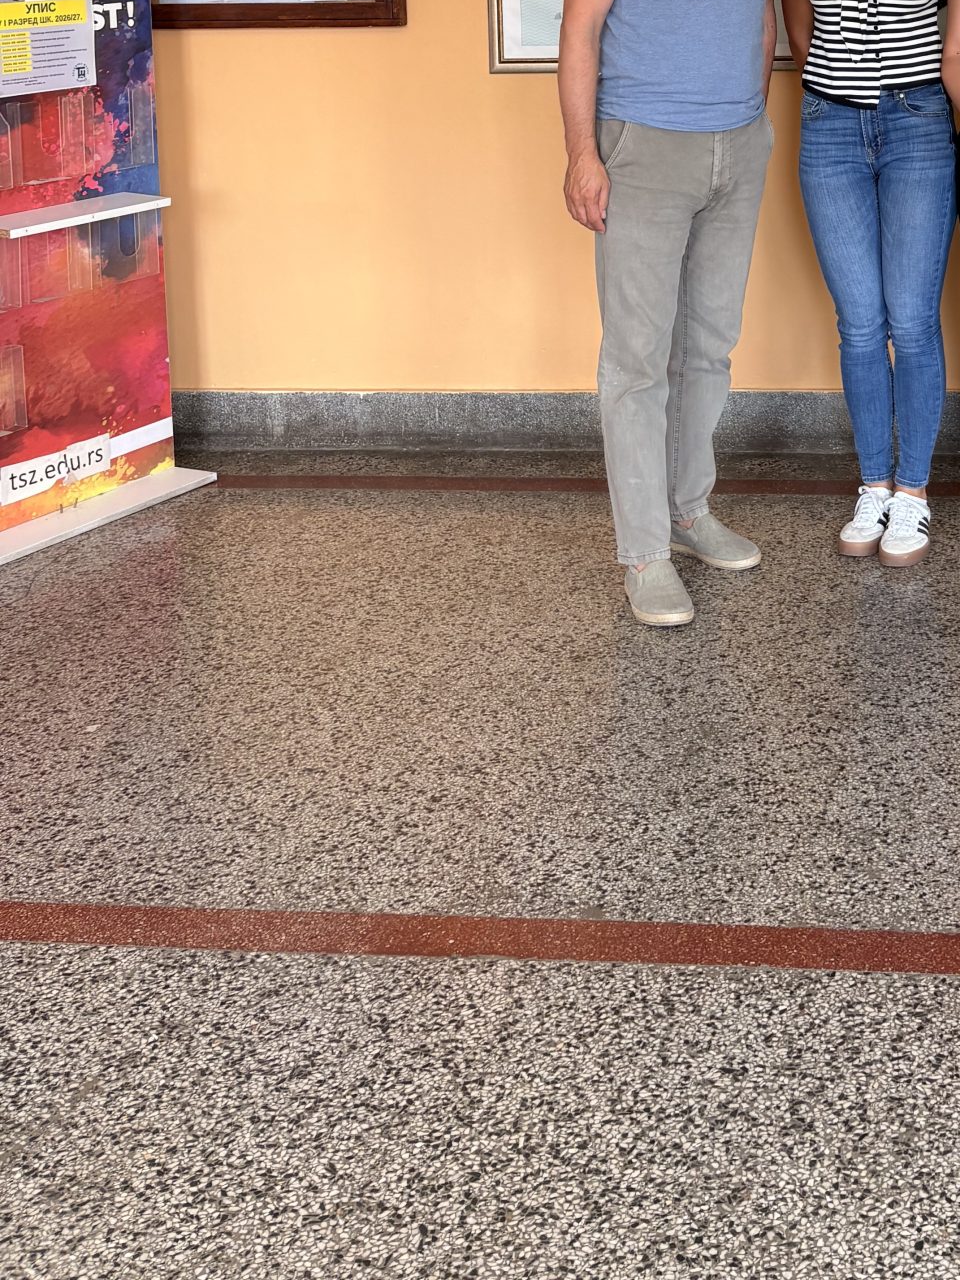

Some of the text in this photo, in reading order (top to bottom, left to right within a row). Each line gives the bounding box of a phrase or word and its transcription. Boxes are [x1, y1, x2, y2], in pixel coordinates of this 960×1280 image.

[25, 2, 57, 15] УПИС
[8, 16, 39, 27] РАЗРЕД
[39, 15, 54, 24] ШК.
[9, 447, 104, 491] tsz.edu.rs
